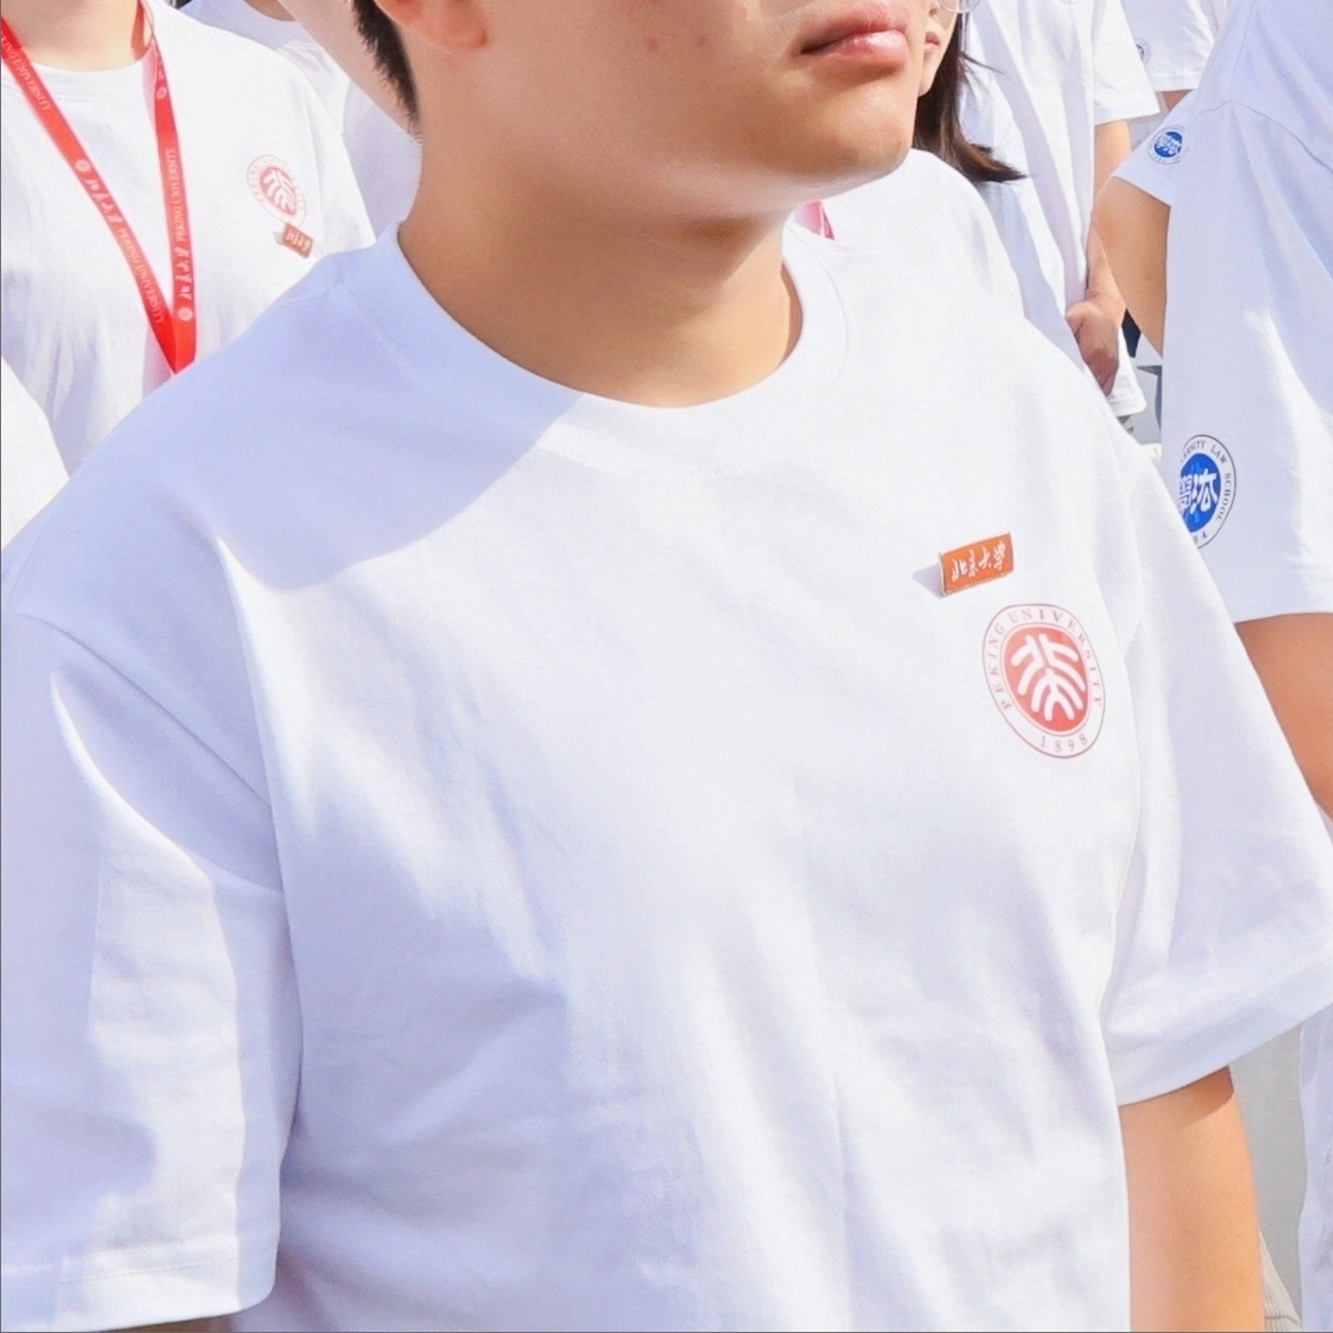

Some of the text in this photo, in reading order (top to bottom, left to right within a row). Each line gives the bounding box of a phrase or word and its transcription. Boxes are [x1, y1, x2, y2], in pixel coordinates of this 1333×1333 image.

[13, 57, 53, 112] UNIVERSITY
[164, 148, 187, 242] PEKING UNIVERSITY
[117, 227, 165, 324] PEKING UNIVERSITY
[1210, 444, 1227, 464] LAW
[1216, 472, 1232, 520] SCHOOL
[951, 539, 1006, 583] 北京大学
[986, 608, 1103, 710] PEKING UNIVERSITY
[1040, 732, 1088, 753] 1898
